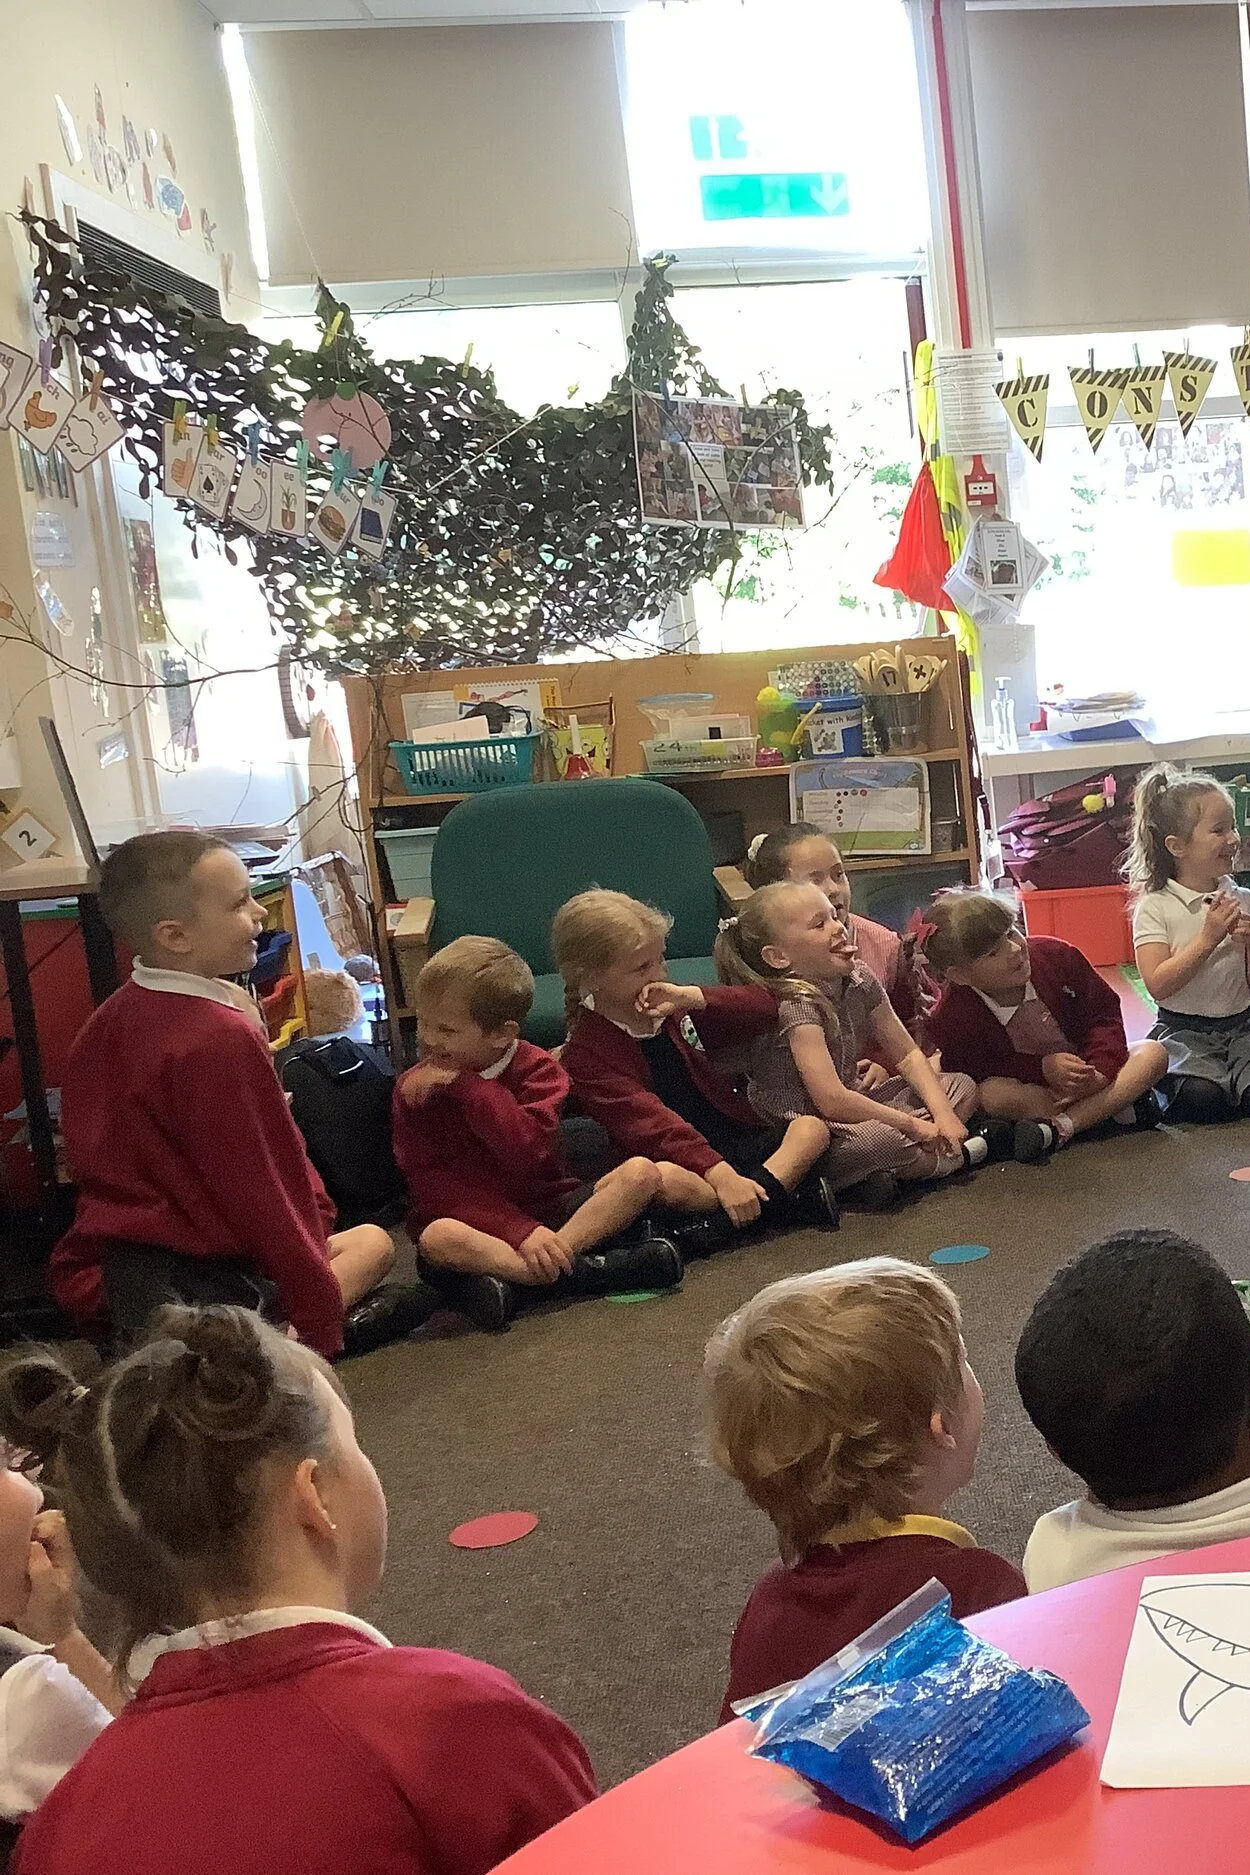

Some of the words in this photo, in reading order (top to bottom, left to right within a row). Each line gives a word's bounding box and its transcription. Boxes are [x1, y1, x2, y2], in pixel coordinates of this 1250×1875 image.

[46, 384, 61, 401] ch
[97, 411, 111, 426] ai
[256, 467, 268, 480] oo
[881, 670, 898, 688] 17
[827, 715, 844, 724] with
[19, 830, 38, 847] 2
